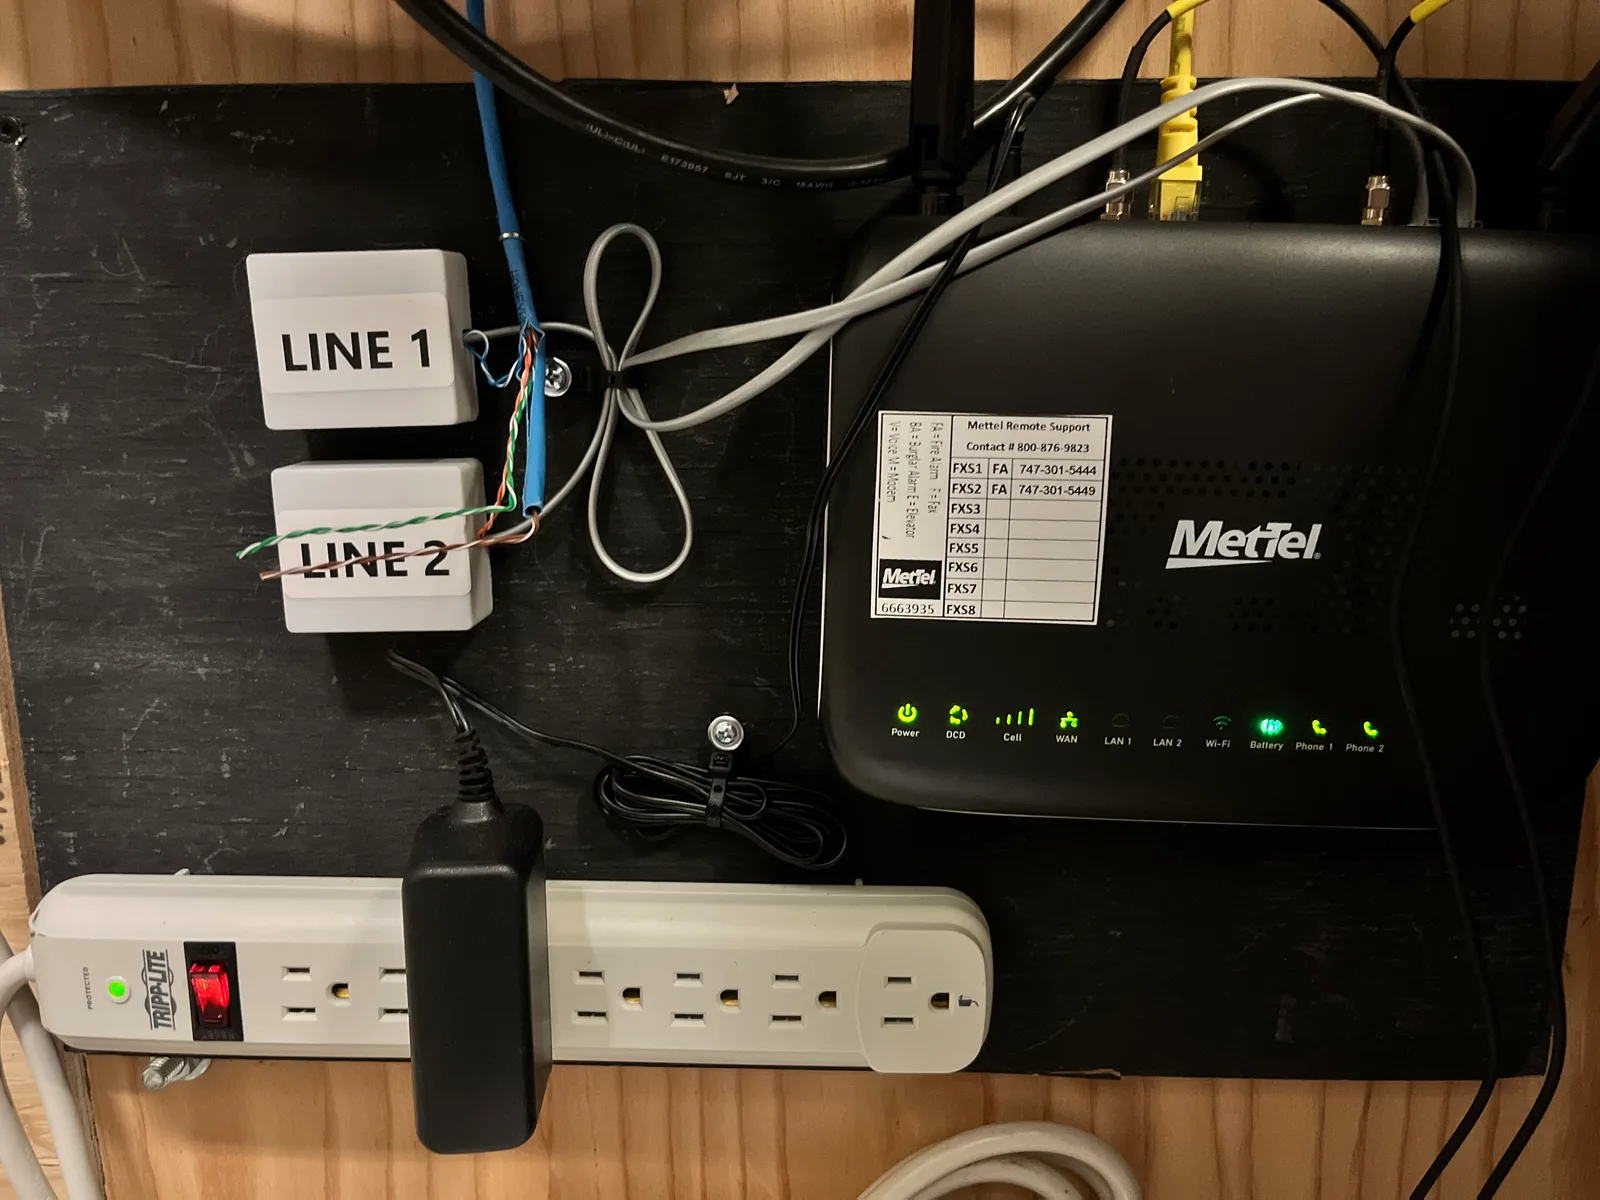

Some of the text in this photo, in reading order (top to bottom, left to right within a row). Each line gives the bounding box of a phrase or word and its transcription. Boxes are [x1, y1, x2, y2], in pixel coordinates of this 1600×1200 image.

[281, 328, 431, 372] LINE 1
[967, 420, 1091, 434] Mettel Remote Support
[966, 442, 1090, 453] Contact # 800-876-9823
[953, 463, 983, 474] FXS1
[992, 463, 1008, 474] FA
[1020, 464, 1097, 476] 747-301-5444
[952, 483, 982, 494] FXS2
[992, 484, 1008, 495] FA
[1019, 485, 1096, 496] 747-301-5449
[951, 503, 981, 514] FXS3
[950, 523, 980, 534] FXS4
[1169, 519, 1323, 559] MetTel
[949, 543, 979, 554] FXS5
[301, 540, 450, 579] LINE 2
[948, 562, 978, 573] FXS6
[882, 567, 936, 586] MetTel
[947, 583, 977, 594] FXS7
[881, 603, 935, 615] 6663935
[946, 604, 976, 615] FXS8
[891, 728, 920, 739] Power
[946, 730, 966, 739] DCD
[1003, 733, 1022, 743] Cell
[1056, 735, 1078, 744] WAN
[1105, 737, 1123, 746] LAN
[1153, 738, 1182, 747] LAN 2
[1205, 739, 1231, 748] Wi-Fi
[1250, 741, 1284, 752] Battery
[1295, 741, 1325, 751] Phone
[1346, 743, 1385, 753] Phone 2
[83, 966, 93, 1010] PROTECTED
